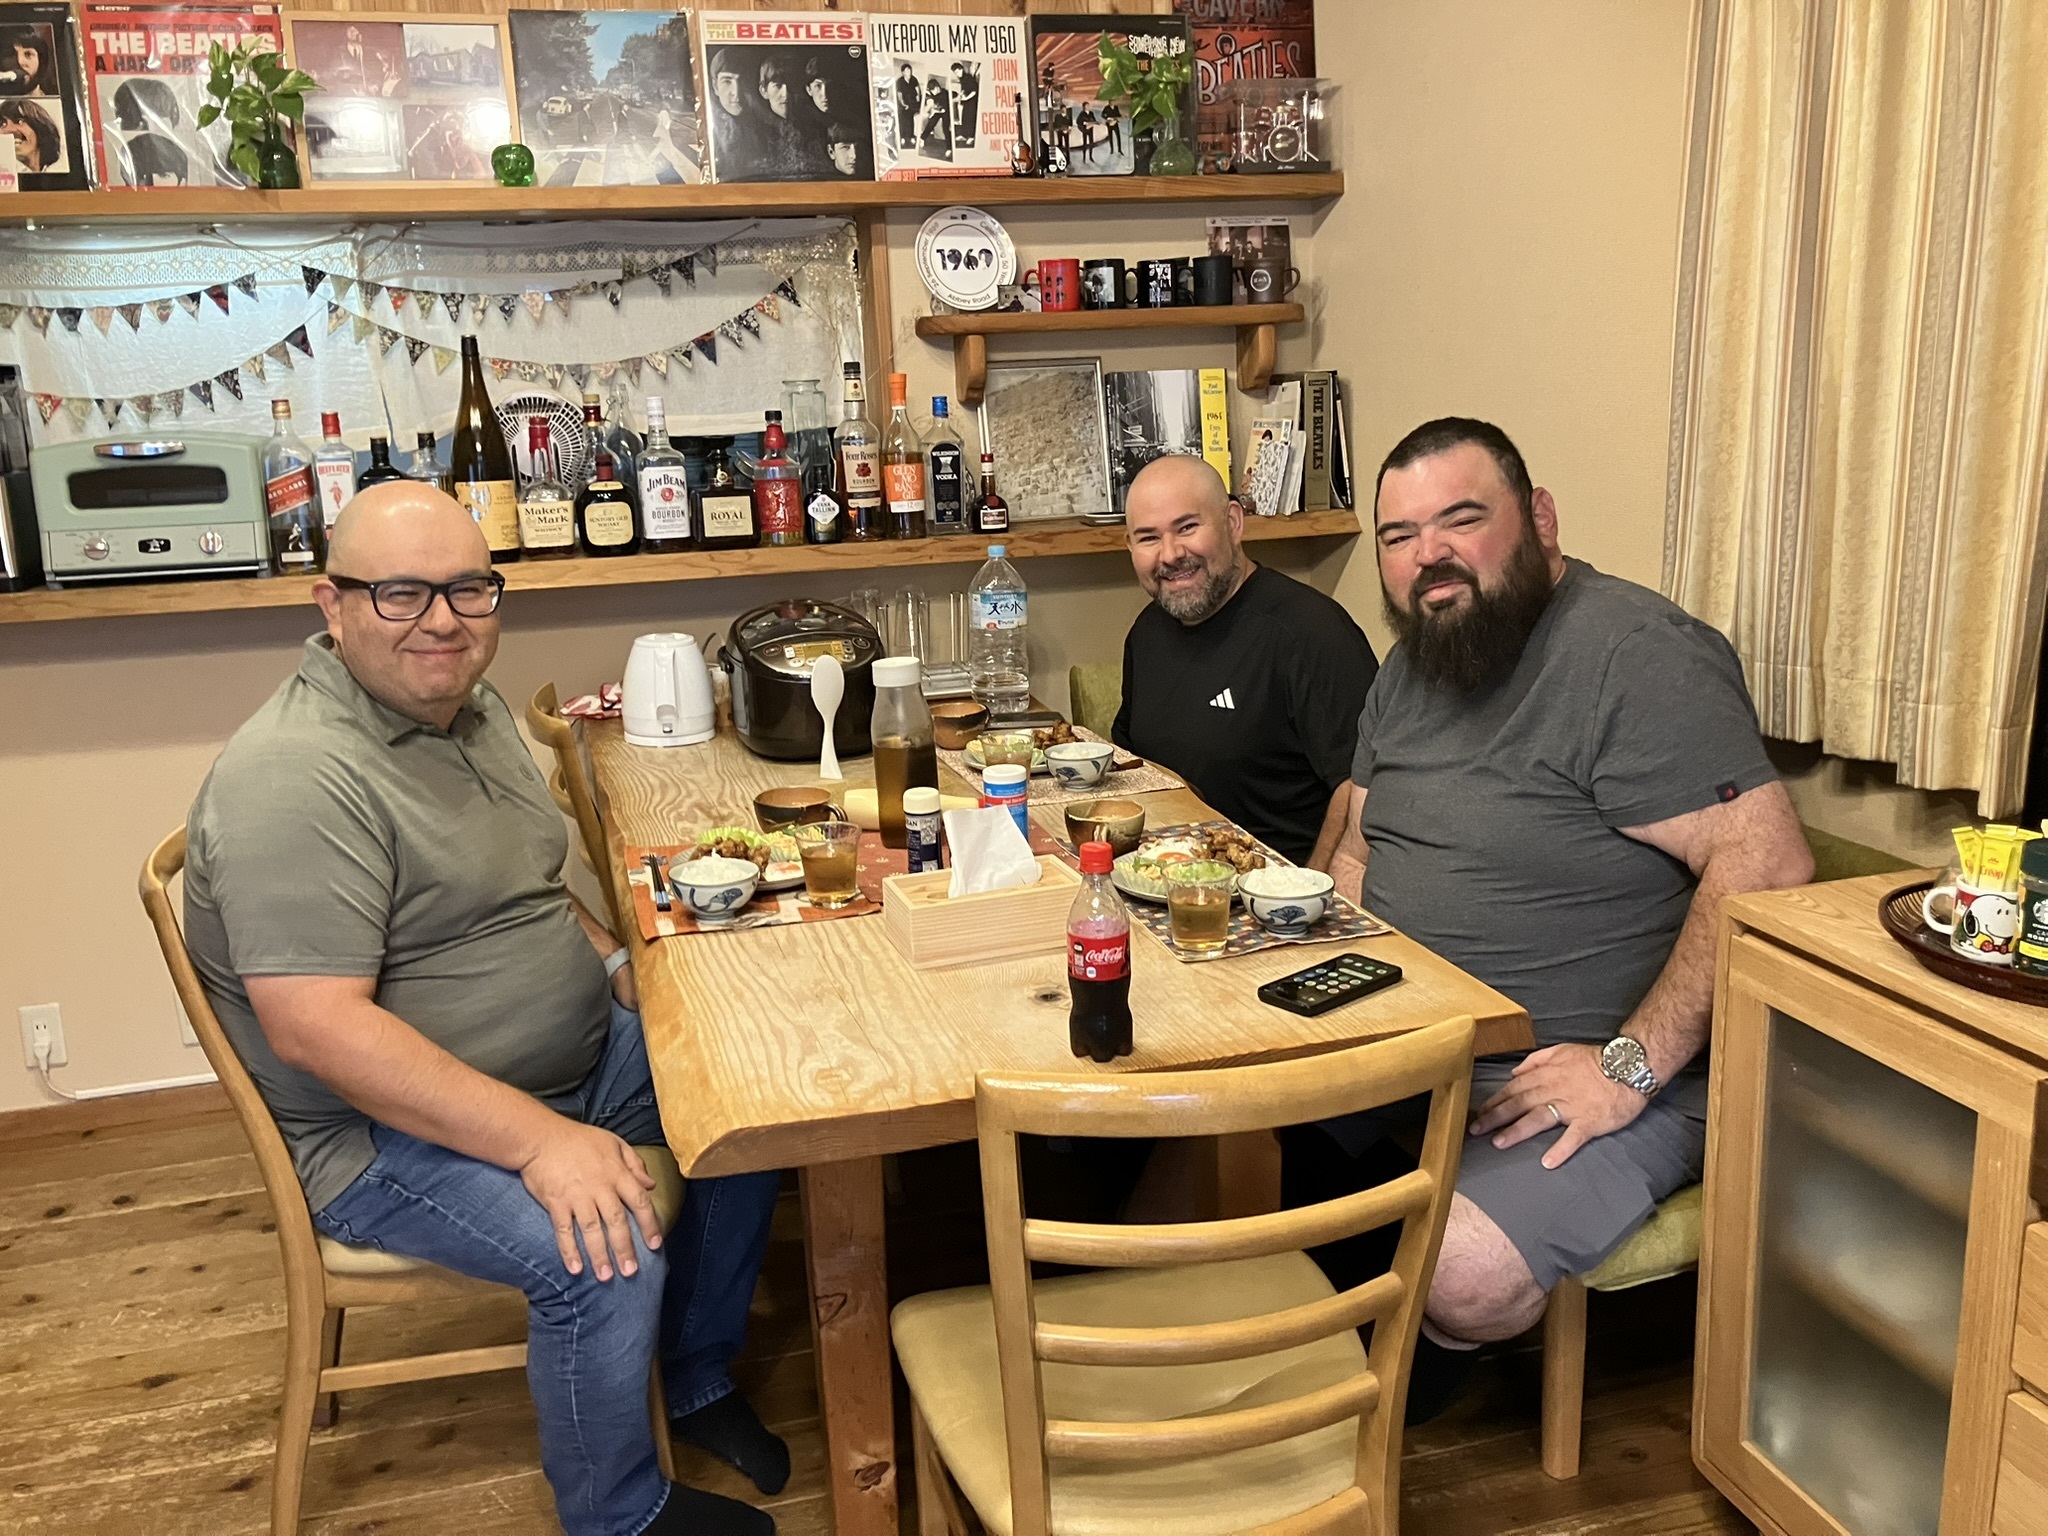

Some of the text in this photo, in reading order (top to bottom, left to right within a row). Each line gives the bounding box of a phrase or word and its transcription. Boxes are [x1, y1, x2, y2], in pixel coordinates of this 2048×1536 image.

[707, 31, 736, 39] THE
[736, 23, 863, 39] BEATLES!
[90, 32, 145, 55] THE
[871, 23, 1017, 54] LIVERPOOL MAY 1960
[95, 55, 107, 72] A
[992, 59, 1018, 81] JOHN
[1136, 60, 1149, 71] THE
[995, 85, 1018, 108] PAU
[982, 112, 1019, 135] GEORG
[936, 248, 994, 271] 1969
[947, 293, 991, 305] Abbey Road
[1312, 387, 1324, 471] THE BEATLES
[893, 465, 916, 476] GLEN
[646, 473, 686, 492] JIM BEAM
[901, 474, 918, 483] MO
[283, 479, 308, 493] LABEL
[895, 482, 913, 492] RAN
[902, 491, 916, 500] GIE
[524, 505, 569, 516] Maker's
[651, 509, 686, 519] BOURBON
[710, 510, 747, 521] ROYAL
[537, 515, 569, 524] Mark
[1085, 946, 1123, 964] Coca-Cola
